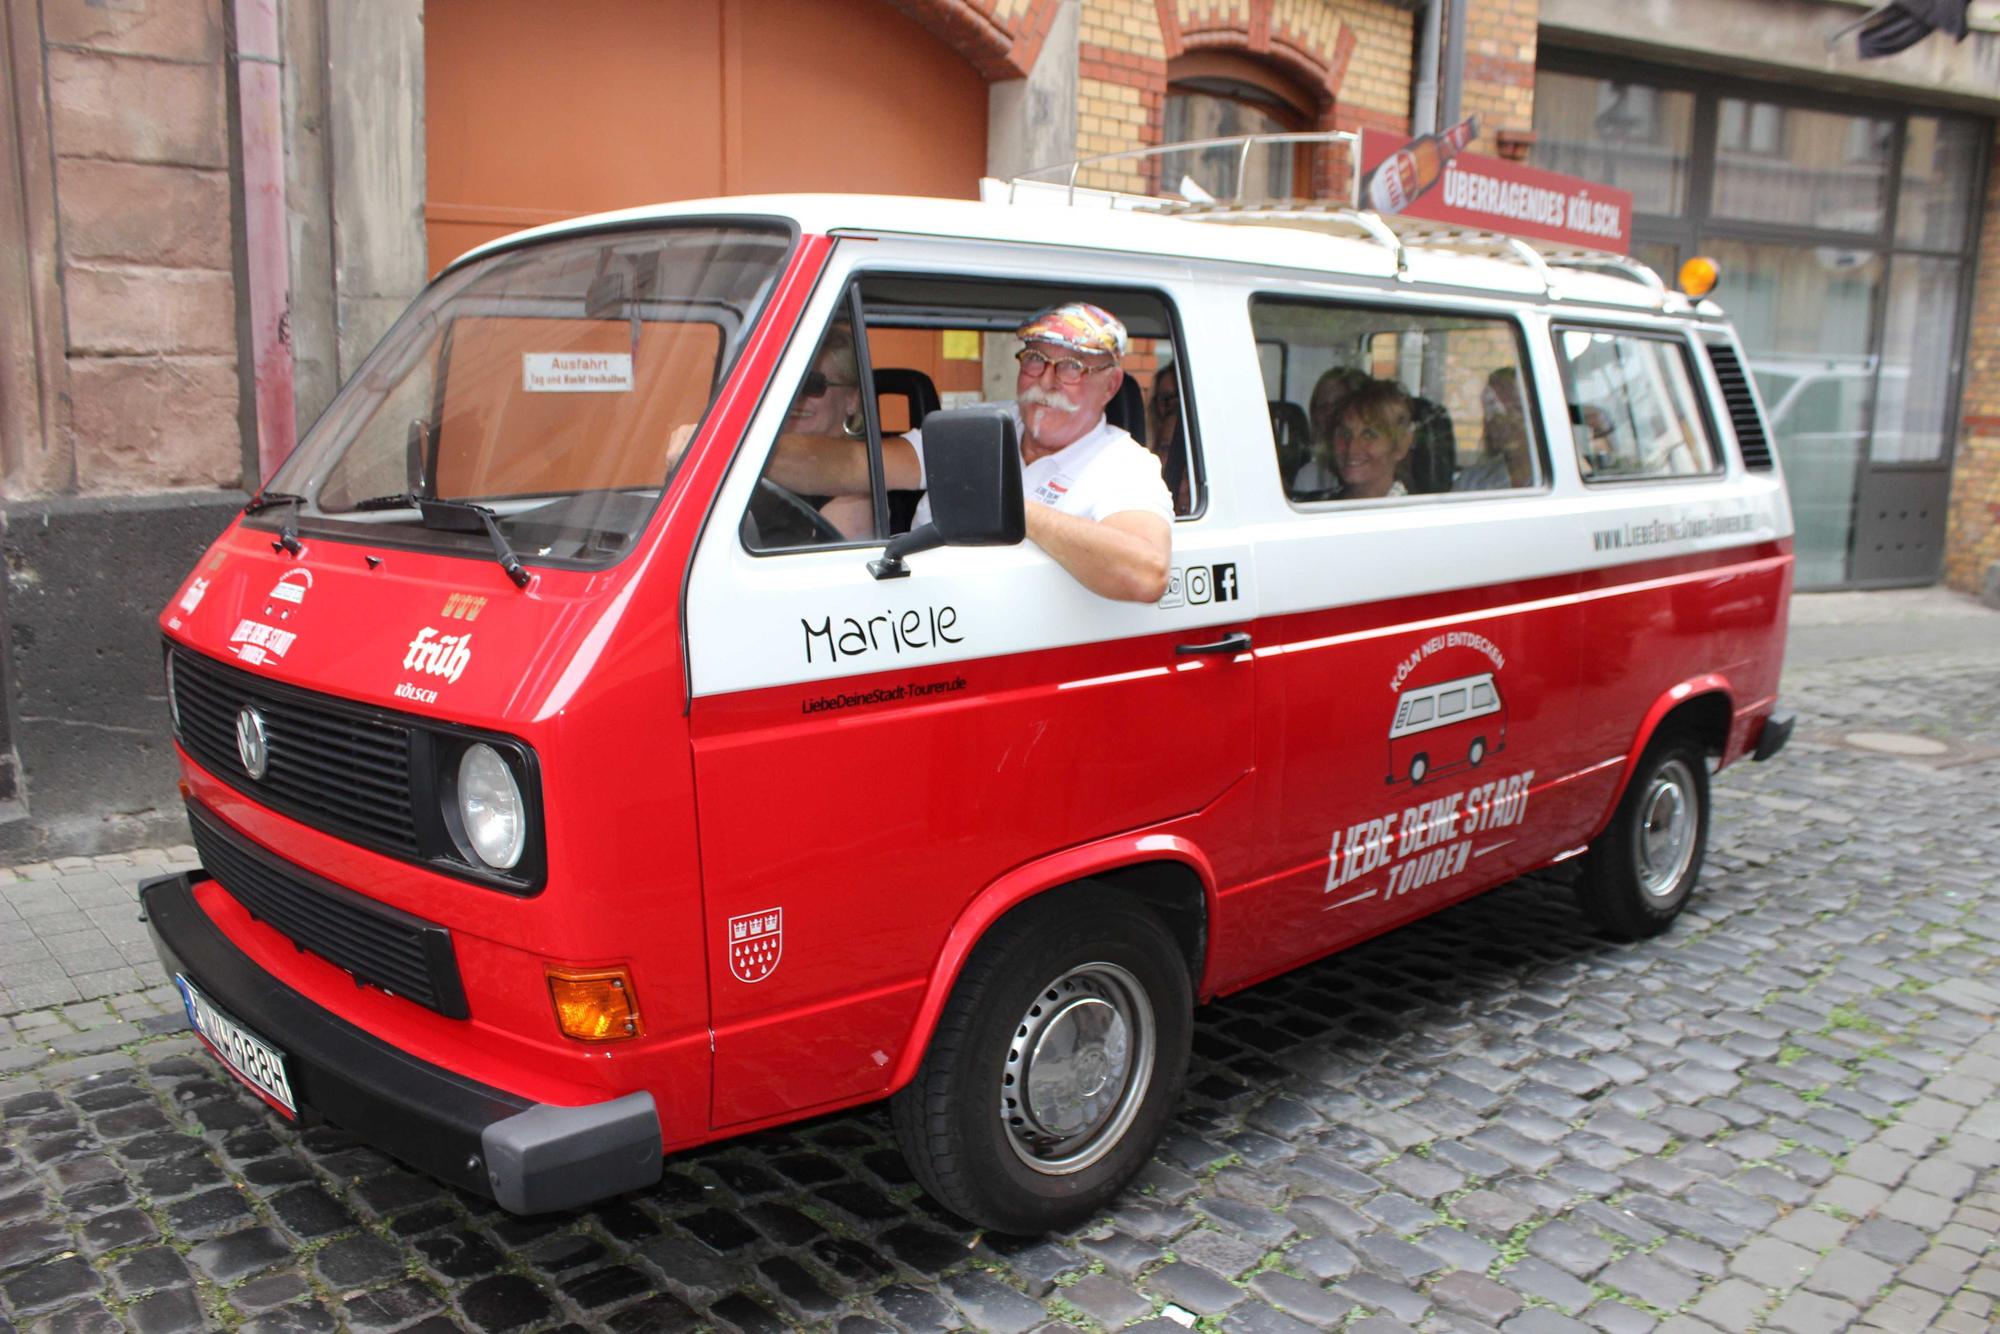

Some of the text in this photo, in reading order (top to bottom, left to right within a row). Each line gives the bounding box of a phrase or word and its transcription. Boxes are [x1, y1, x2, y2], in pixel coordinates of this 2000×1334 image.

[1443, 159, 1622, 239] ÜBERRAGENDES KÖLSCH.
[551, 356, 608, 371] Ausfahrt
[801, 606, 965, 663] Mariele
[1390, 631, 1506, 692] KÖLN NEU ENTDECKEN
[394, 682, 438, 704] KÖLSCH
[801, 676, 967, 714] LiebeDeineStadt-Touren.de
[1324, 770, 1535, 893] LIEBE DEINE STADT
[1384, 840, 1472, 900] TOUREN
